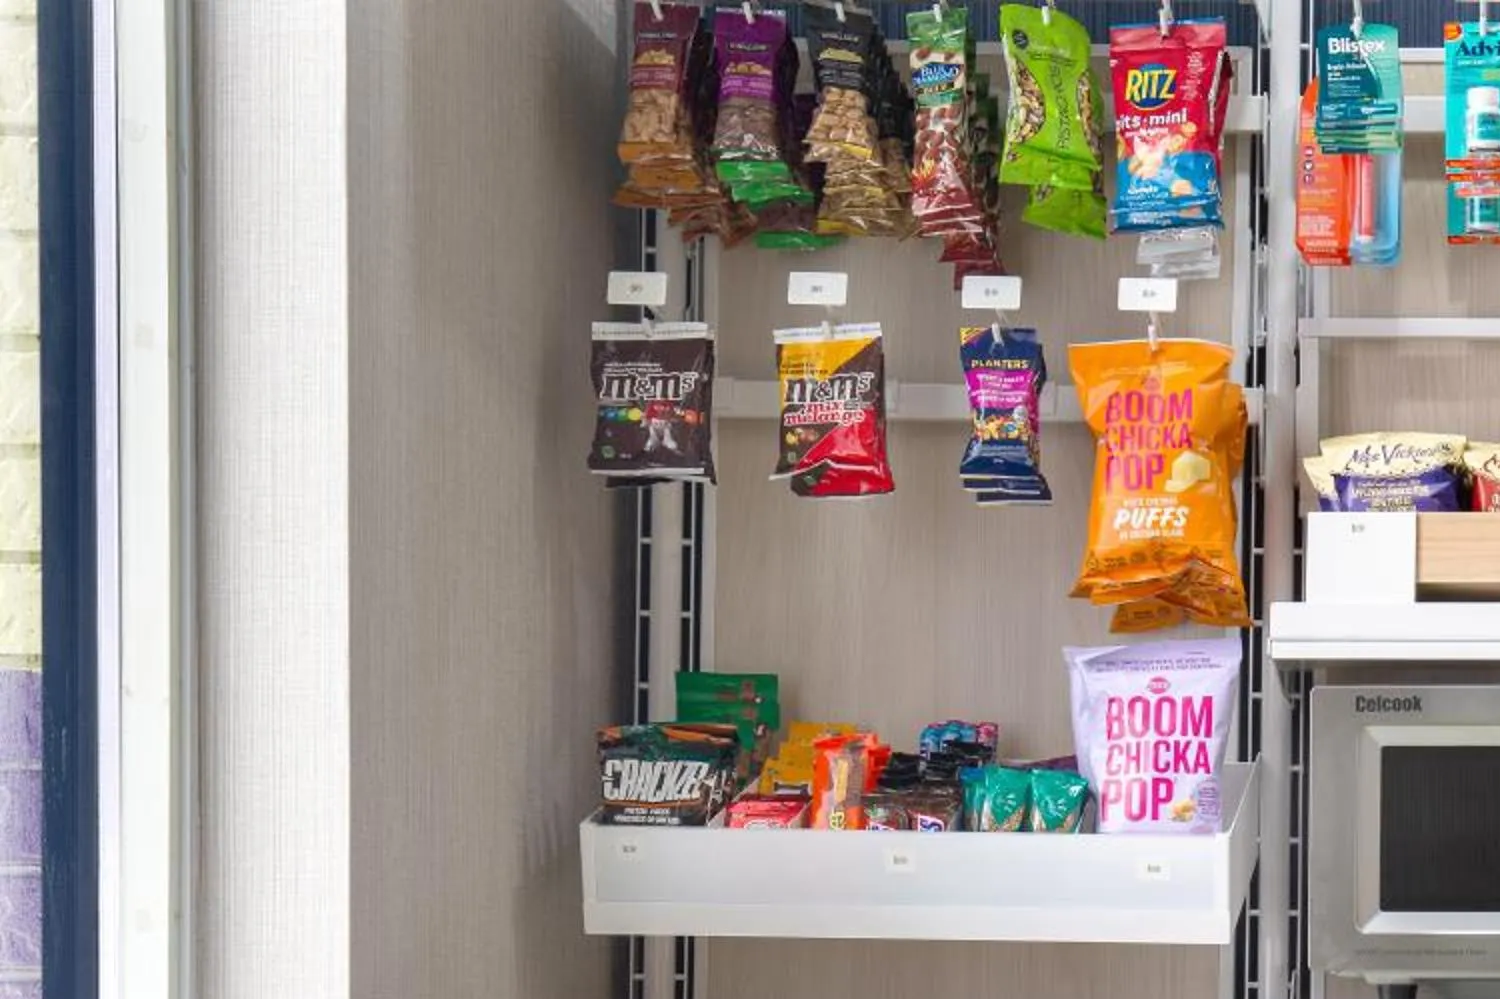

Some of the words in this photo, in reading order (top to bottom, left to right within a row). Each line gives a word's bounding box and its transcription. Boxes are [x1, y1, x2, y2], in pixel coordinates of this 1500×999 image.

[1327, 37, 1386, 55] Blistex
[1124, 68, 1177, 102] RITZ
[1149, 107, 1188, 126] mini
[971, 359, 1030, 370] PLANTERS
[1105, 388, 1193, 425] BOOM
[1103, 422, 1194, 453] CHICKA
[1104, 453, 1165, 493] POP
[1113, 505, 1190, 531] PUFFS
[1106, 695, 1214, 741] BOOM
[1354, 695, 1423, 713] Celcook
[1105, 739, 1212, 776] CHICKA
[1101, 777, 1175, 823] POP
